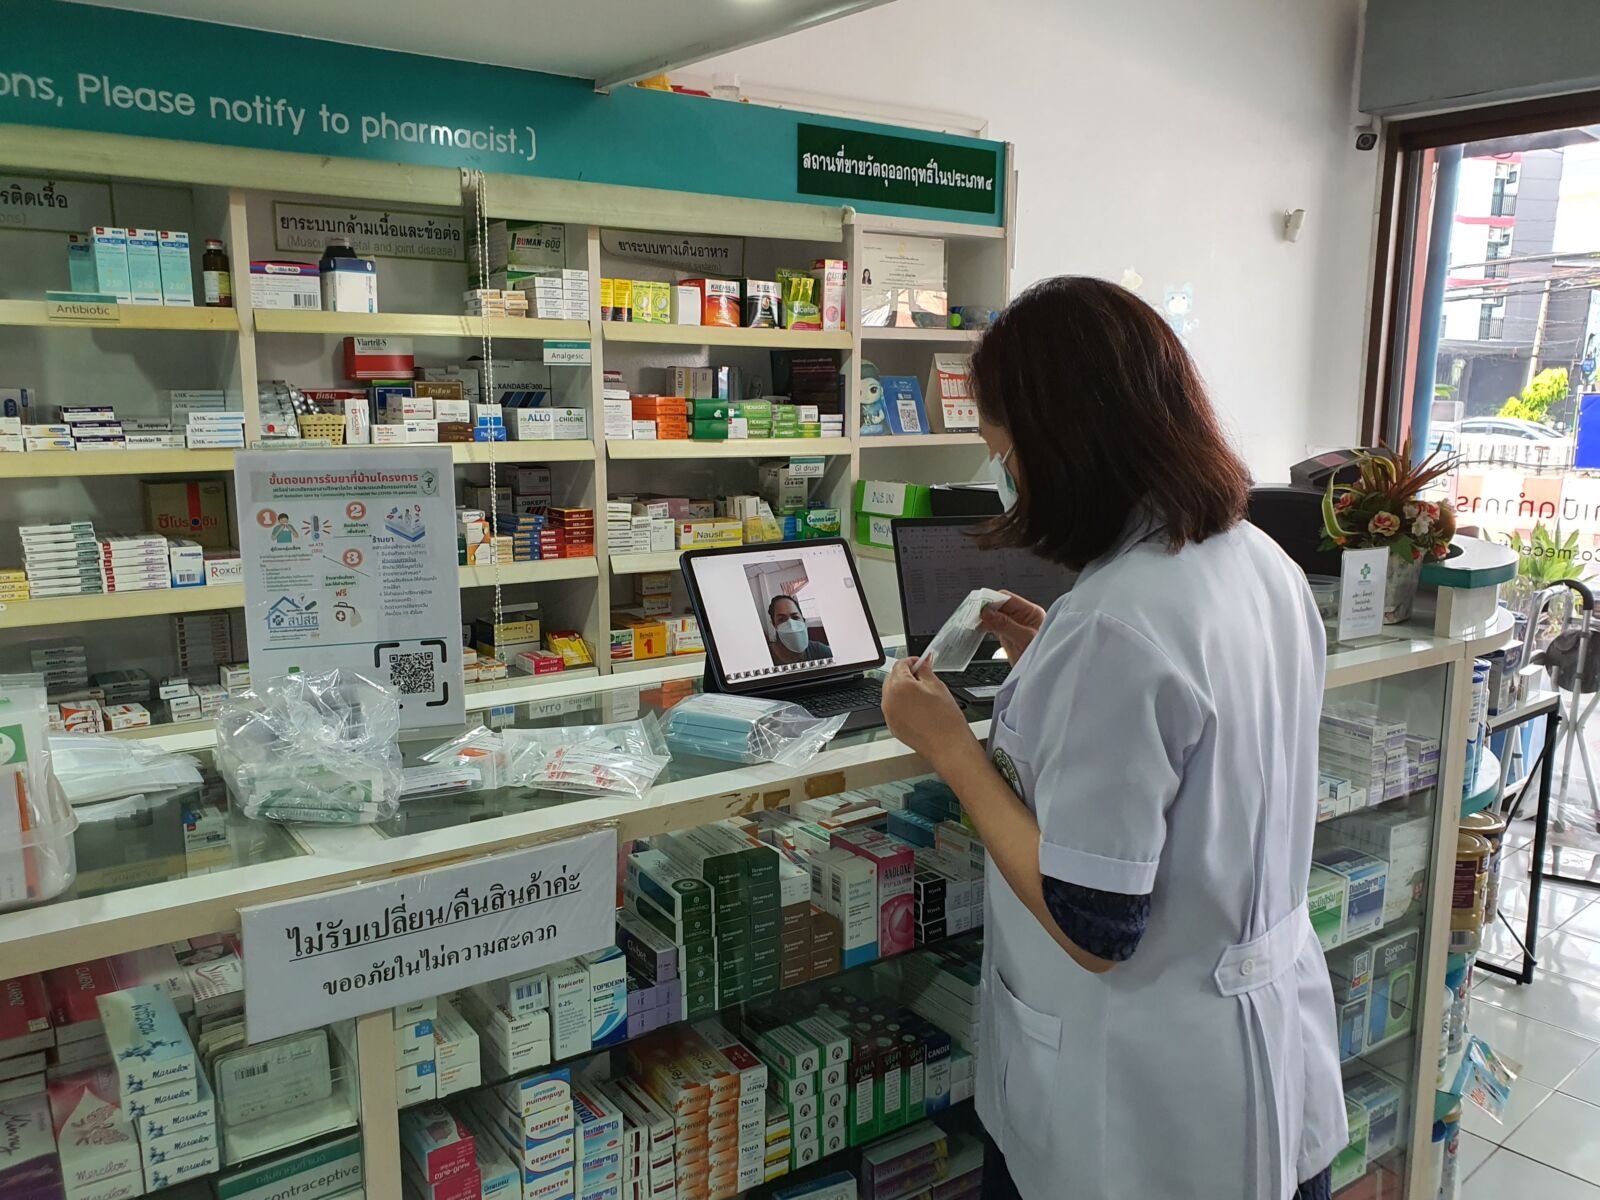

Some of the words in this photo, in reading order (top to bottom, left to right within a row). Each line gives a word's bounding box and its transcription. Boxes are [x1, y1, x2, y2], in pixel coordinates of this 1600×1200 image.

[77, 73, 196, 116] Please
[209, 94, 305, 136] notify
[319, 103, 350, 134] to
[56, 303, 111, 317] Antibiotic
[356, 338, 388, 347] Viartril-S
[551, 352, 584, 361] Analgesic
[528, 413, 551, 422] ALLO
[349, 503, 363, 517] 2
[262, 511, 273, 525] 1
[346, 551, 360, 565] 3
[643, 639, 654, 654] 1
[285, 864, 582, 958] ไม่รับเปลี่ยน/คืนสินค้าค่ะ
[322, 923, 558, 997] ขออภัยในไม่ความสะดวก
[557, 977, 584, 990] Topicorte
[152, 1062, 191, 1078] Marvelon
[154, 1088, 193, 1105] Marvelon
[741, 1095, 759, 1106] Nora
[172, 1108, 210, 1125] Marvelon
[530, 1113, 570, 1133] DEXPENTEN
[741, 1119, 760, 1130] Nora
[174, 1134, 212, 1150] Marvelon
[741, 1143, 760, 1154] Nora
[530, 1146, 570, 1165] DEXPENTEN
[177, 1157, 215, 1174] Marvelon
[740, 1166, 758, 1178] Nora
[529, 1178, 569, 1199] DEXPENTEN
